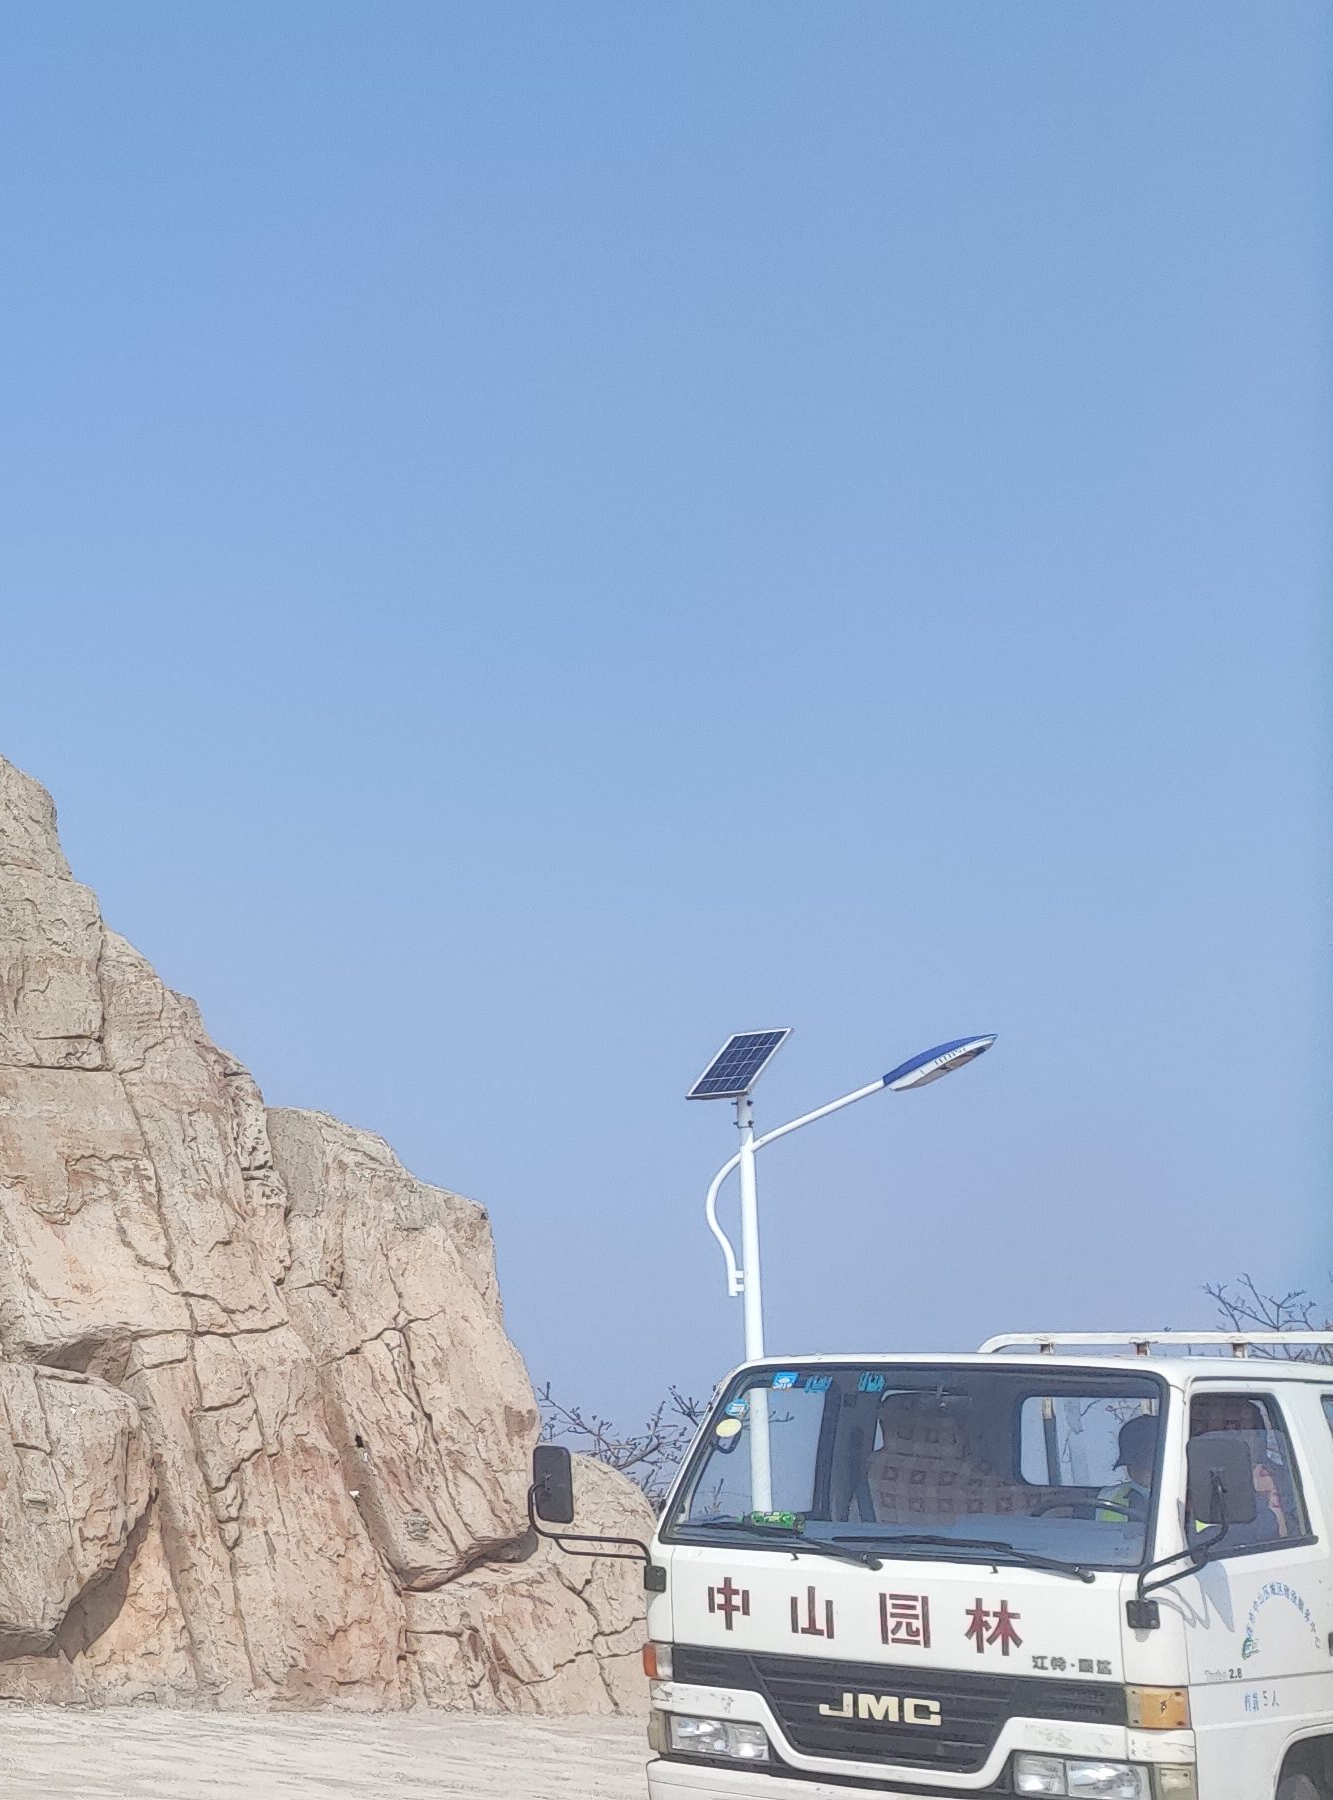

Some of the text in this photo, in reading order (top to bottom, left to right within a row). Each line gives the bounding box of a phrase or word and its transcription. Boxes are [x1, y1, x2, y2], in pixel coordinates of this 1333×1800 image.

[707, 1576, 1024, 1657] 中山园林
[1228, 1667, 1243, 1679] 2.8
[818, 1692, 942, 1727] JMC
